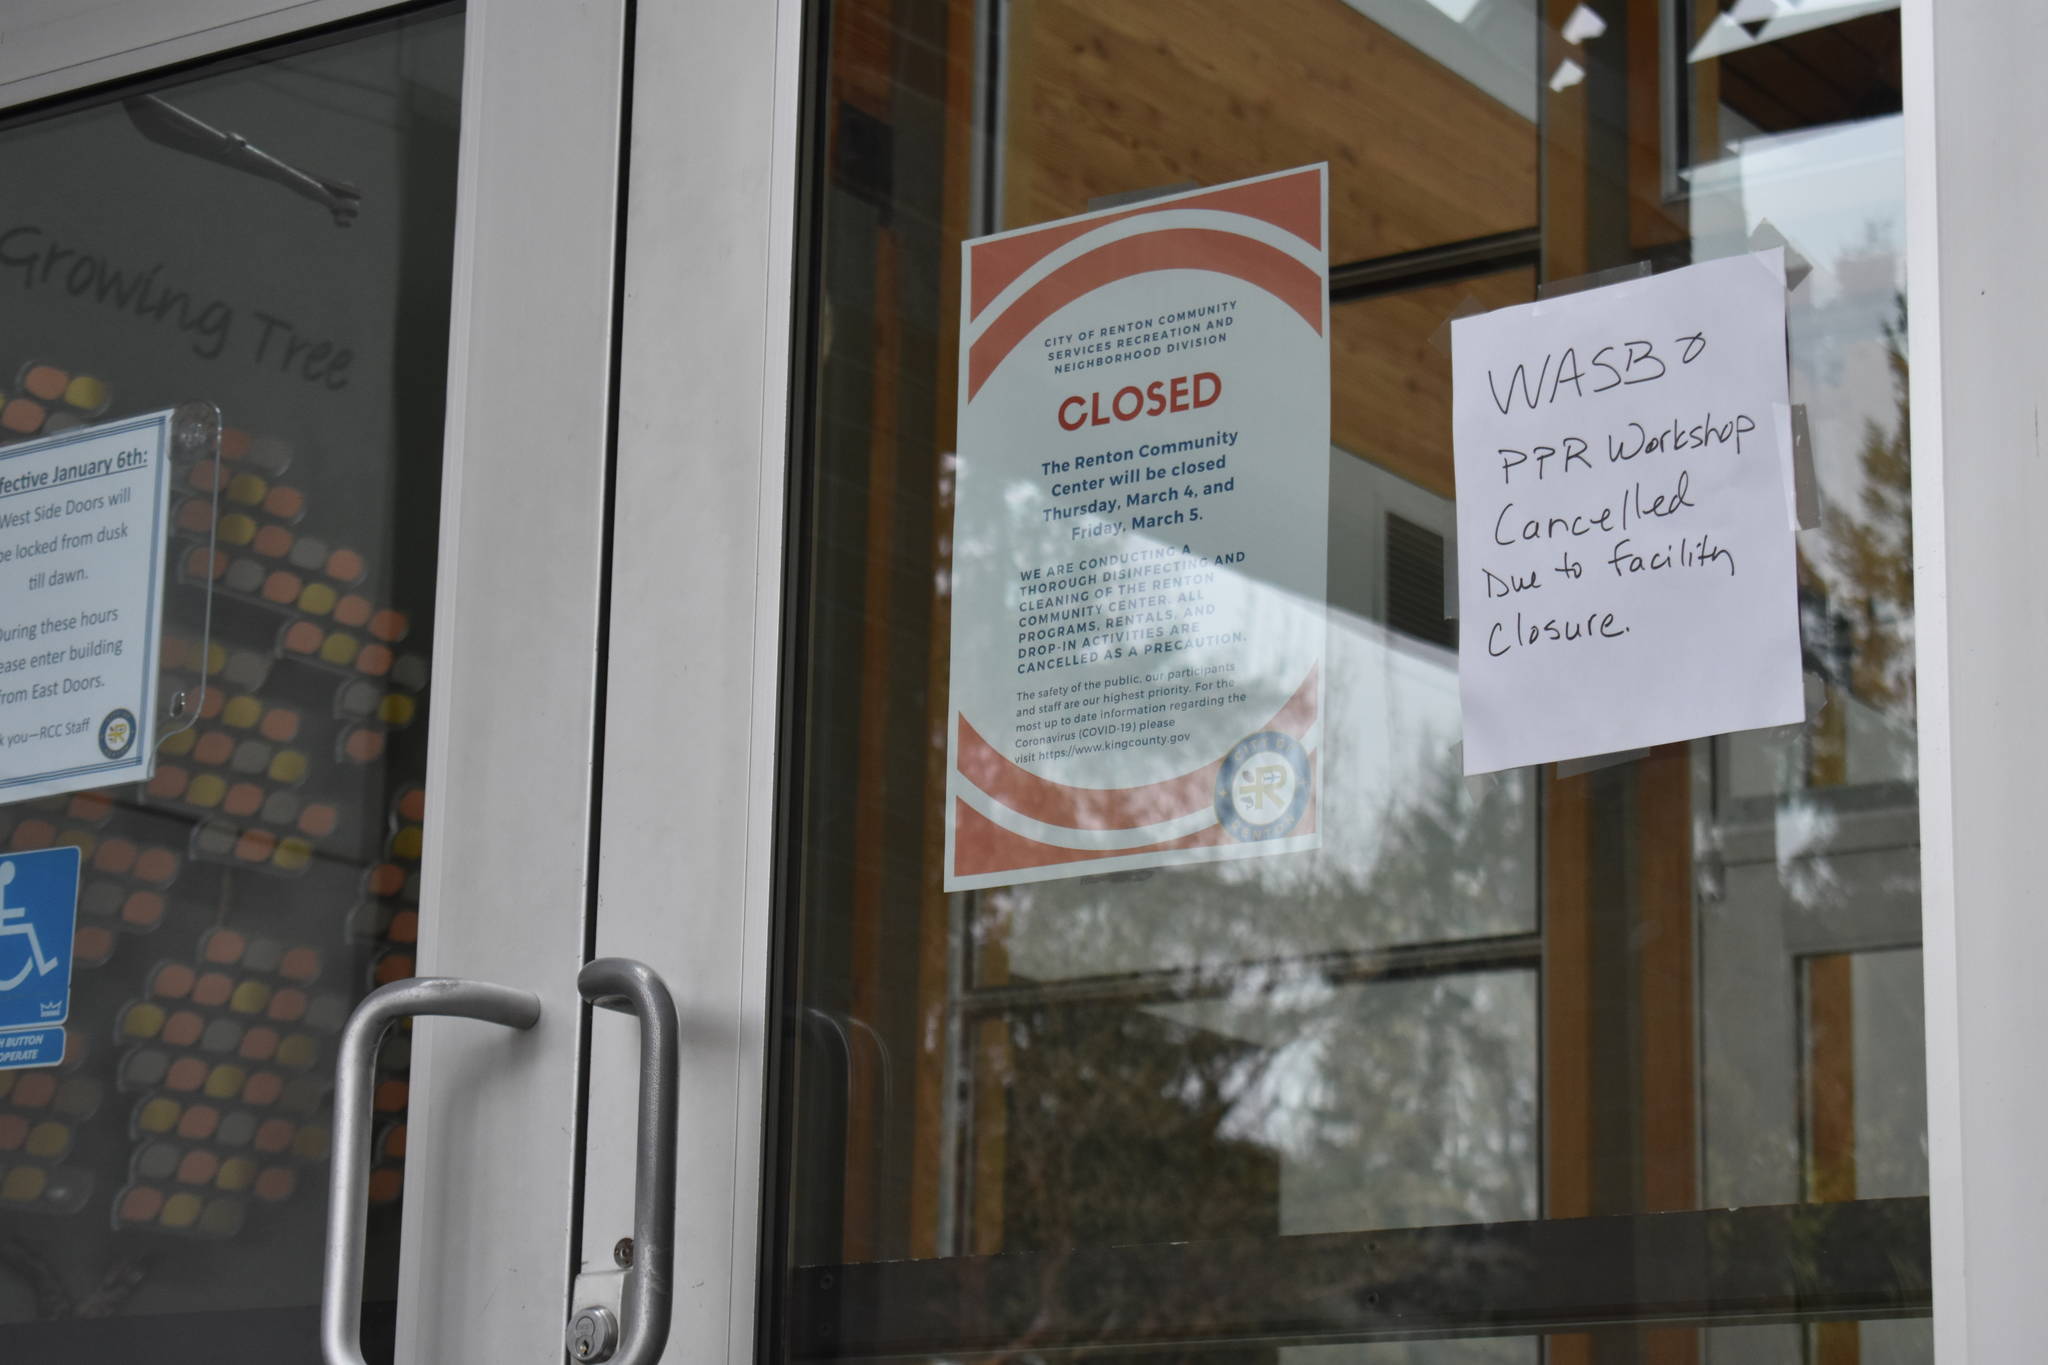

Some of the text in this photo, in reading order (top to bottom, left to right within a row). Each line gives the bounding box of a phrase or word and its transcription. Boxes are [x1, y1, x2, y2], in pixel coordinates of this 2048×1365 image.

[0, 225, 355, 391] Growing Tree
[1044, 300, 1238, 348] CITY OF RENTON COMMUNITY
[1047, 316, 1234, 362] SERVICES RECREATION AND
[1054, 333, 1227, 375] NEIGHBORHOOD DIVISION
[1057, 371, 1222, 432] CLOSED
[52, 456, 114, 484] January
[116, 446, 149, 470] 6th:
[1041, 430, 1239, 477] The Renton Community
[1497, 412, 1756, 485] PPR Workshop
[1051, 454, 1227, 498] Center will be closed
[0, 486, 132, 530] West Side Doors will
[1042, 477, 1235, 523] Thursday, March 4, and
[1494, 470, 1695, 546] Cancelled
[15, 535, 58, 560] locked
[61, 532, 93, 551] from
[96, 521, 129, 543] dusk
[1071, 507, 1203, 541] Friday, March 5.
[28, 567, 89, 591] till dawn.
[1020, 544, 1191, 582] WE ARE CONDUCTING A
[1020, 551, 1246, 597] THOROUGH DISINFECTING AND
[1481, 567, 1542, 598] Due
[1554, 551, 1583, 579] to
[1018, 604, 1103, 629] COMMUNITY
[1177, 590, 1205, 603] ALL
[1019, 571, 1215, 613] CLEANING OF THE RENTON
[1183, 603, 1216, 619] AND
[40, 616, 78, 635] these
[80, 608, 119, 628] hours
[1017, 622, 1200, 660] DROP-IN ACTIVITIES ARE
[30, 649, 66, 669] enter
[69, 639, 124, 661] building
[1017, 631, 1248, 675] CANCELLED AS A PRECAUTION.
[31, 682, 59, 700] East
[62, 674, 106, 694] Doors.
[1015, 706, 1036, 719] and
[1038, 700, 1062, 714] staff
[1063, 700, 1080, 711] are
[1082, 695, 1101, 707] our
[1102, 689, 1145, 706] highest
[1195, 680, 1213, 693] For
[1216, 677, 1236, 689] the
[1016, 690, 1036, 703] The
[1038, 686, 1068, 700] safety
[1070, 682, 1083, 694] of
[1084, 679, 1101, 691] the
[1145, 673, 1164, 683] our
[1167, 662, 1236, 682] participants
[65, 716, 91, 736] Staff
[1015, 691, 1247, 733] most up to date information regarding the
[1013, 731, 1191, 765] visit https://www.kingcounty.gov
[1014, 717, 1176, 750] Coronavirus (COVID-19) please
[5, 1033, 44, 1048] BUTTON
